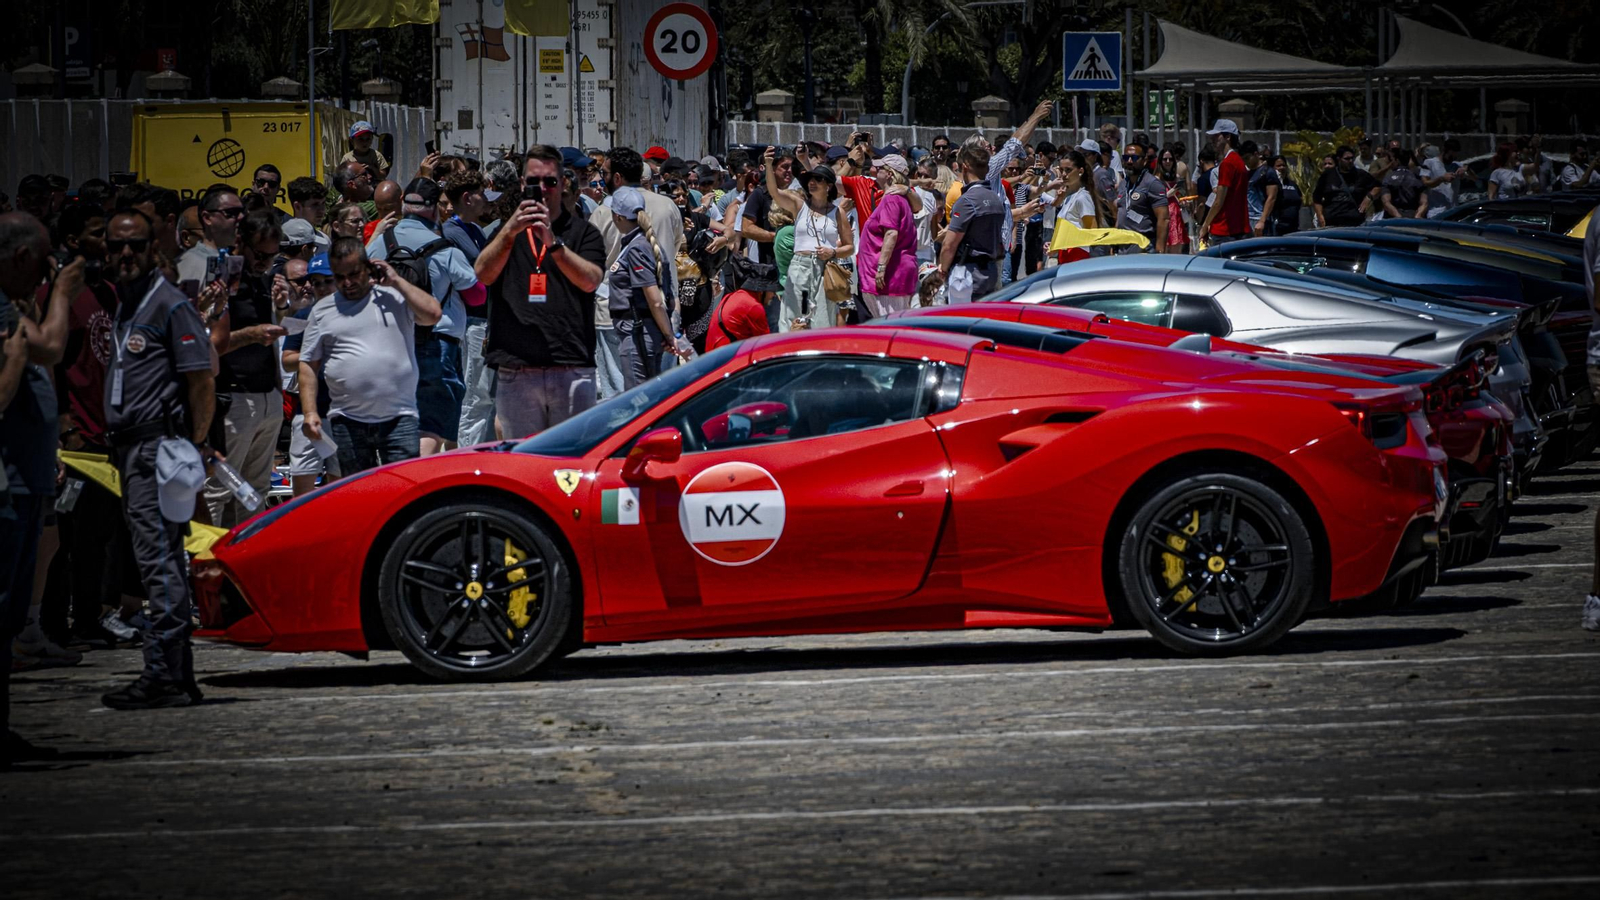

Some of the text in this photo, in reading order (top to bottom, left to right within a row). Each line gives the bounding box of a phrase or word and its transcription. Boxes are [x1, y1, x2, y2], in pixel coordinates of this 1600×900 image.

[65, 26, 80, 56] P
[660, 29, 701, 54] 20
[263, 121, 302, 133] 23 017
[705, 502, 762, 527] MX
